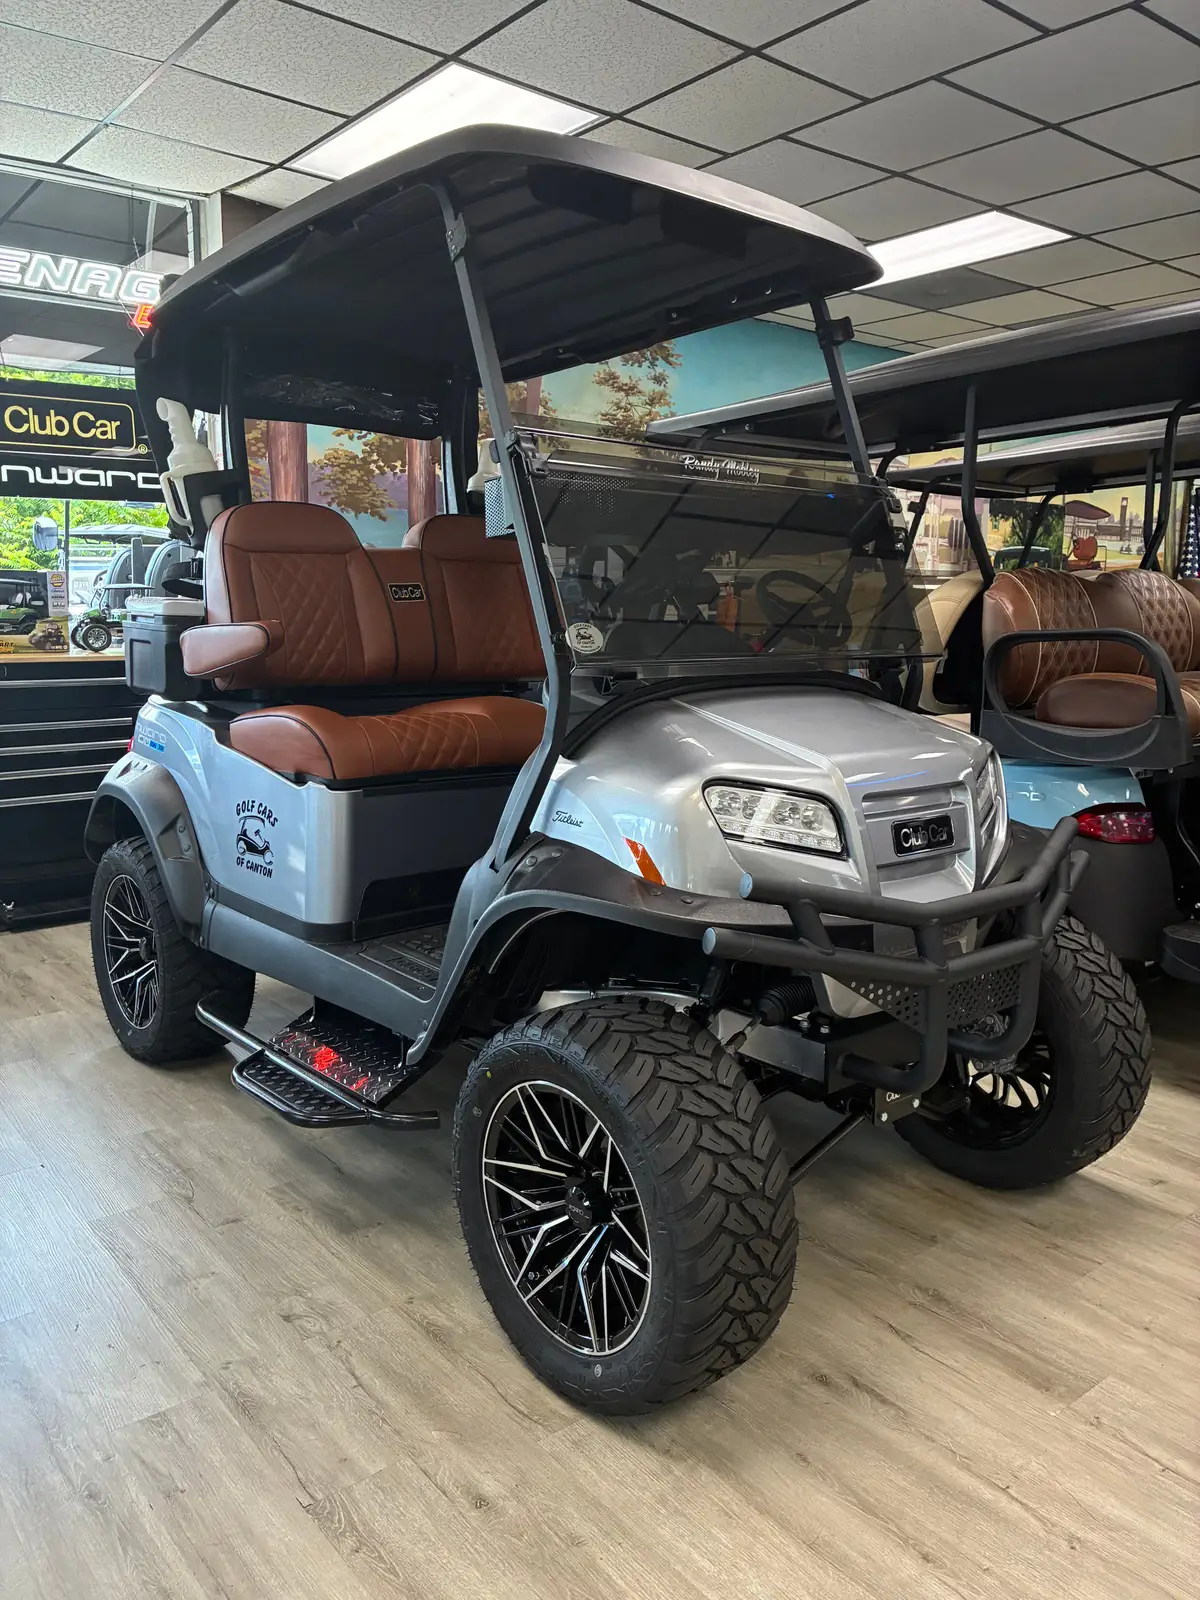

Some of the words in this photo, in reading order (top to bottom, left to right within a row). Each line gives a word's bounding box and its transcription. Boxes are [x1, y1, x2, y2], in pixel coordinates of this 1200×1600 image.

[4, 405, 70, 437] Club
[72, 410, 121, 440] Car
[681, 454, 720, 481] Randy
[391, 587, 409, 598] Club
[408, 587, 422, 598] Car
[236, 799, 256, 817] GOLF
[257, 802, 279, 828] CARS
[551, 810, 584, 828] Titleist
[900, 827, 928, 848] Club
[928, 824, 949, 842] Car
[236, 855, 246, 868] OF
[245, 859, 274, 879] CANTON
